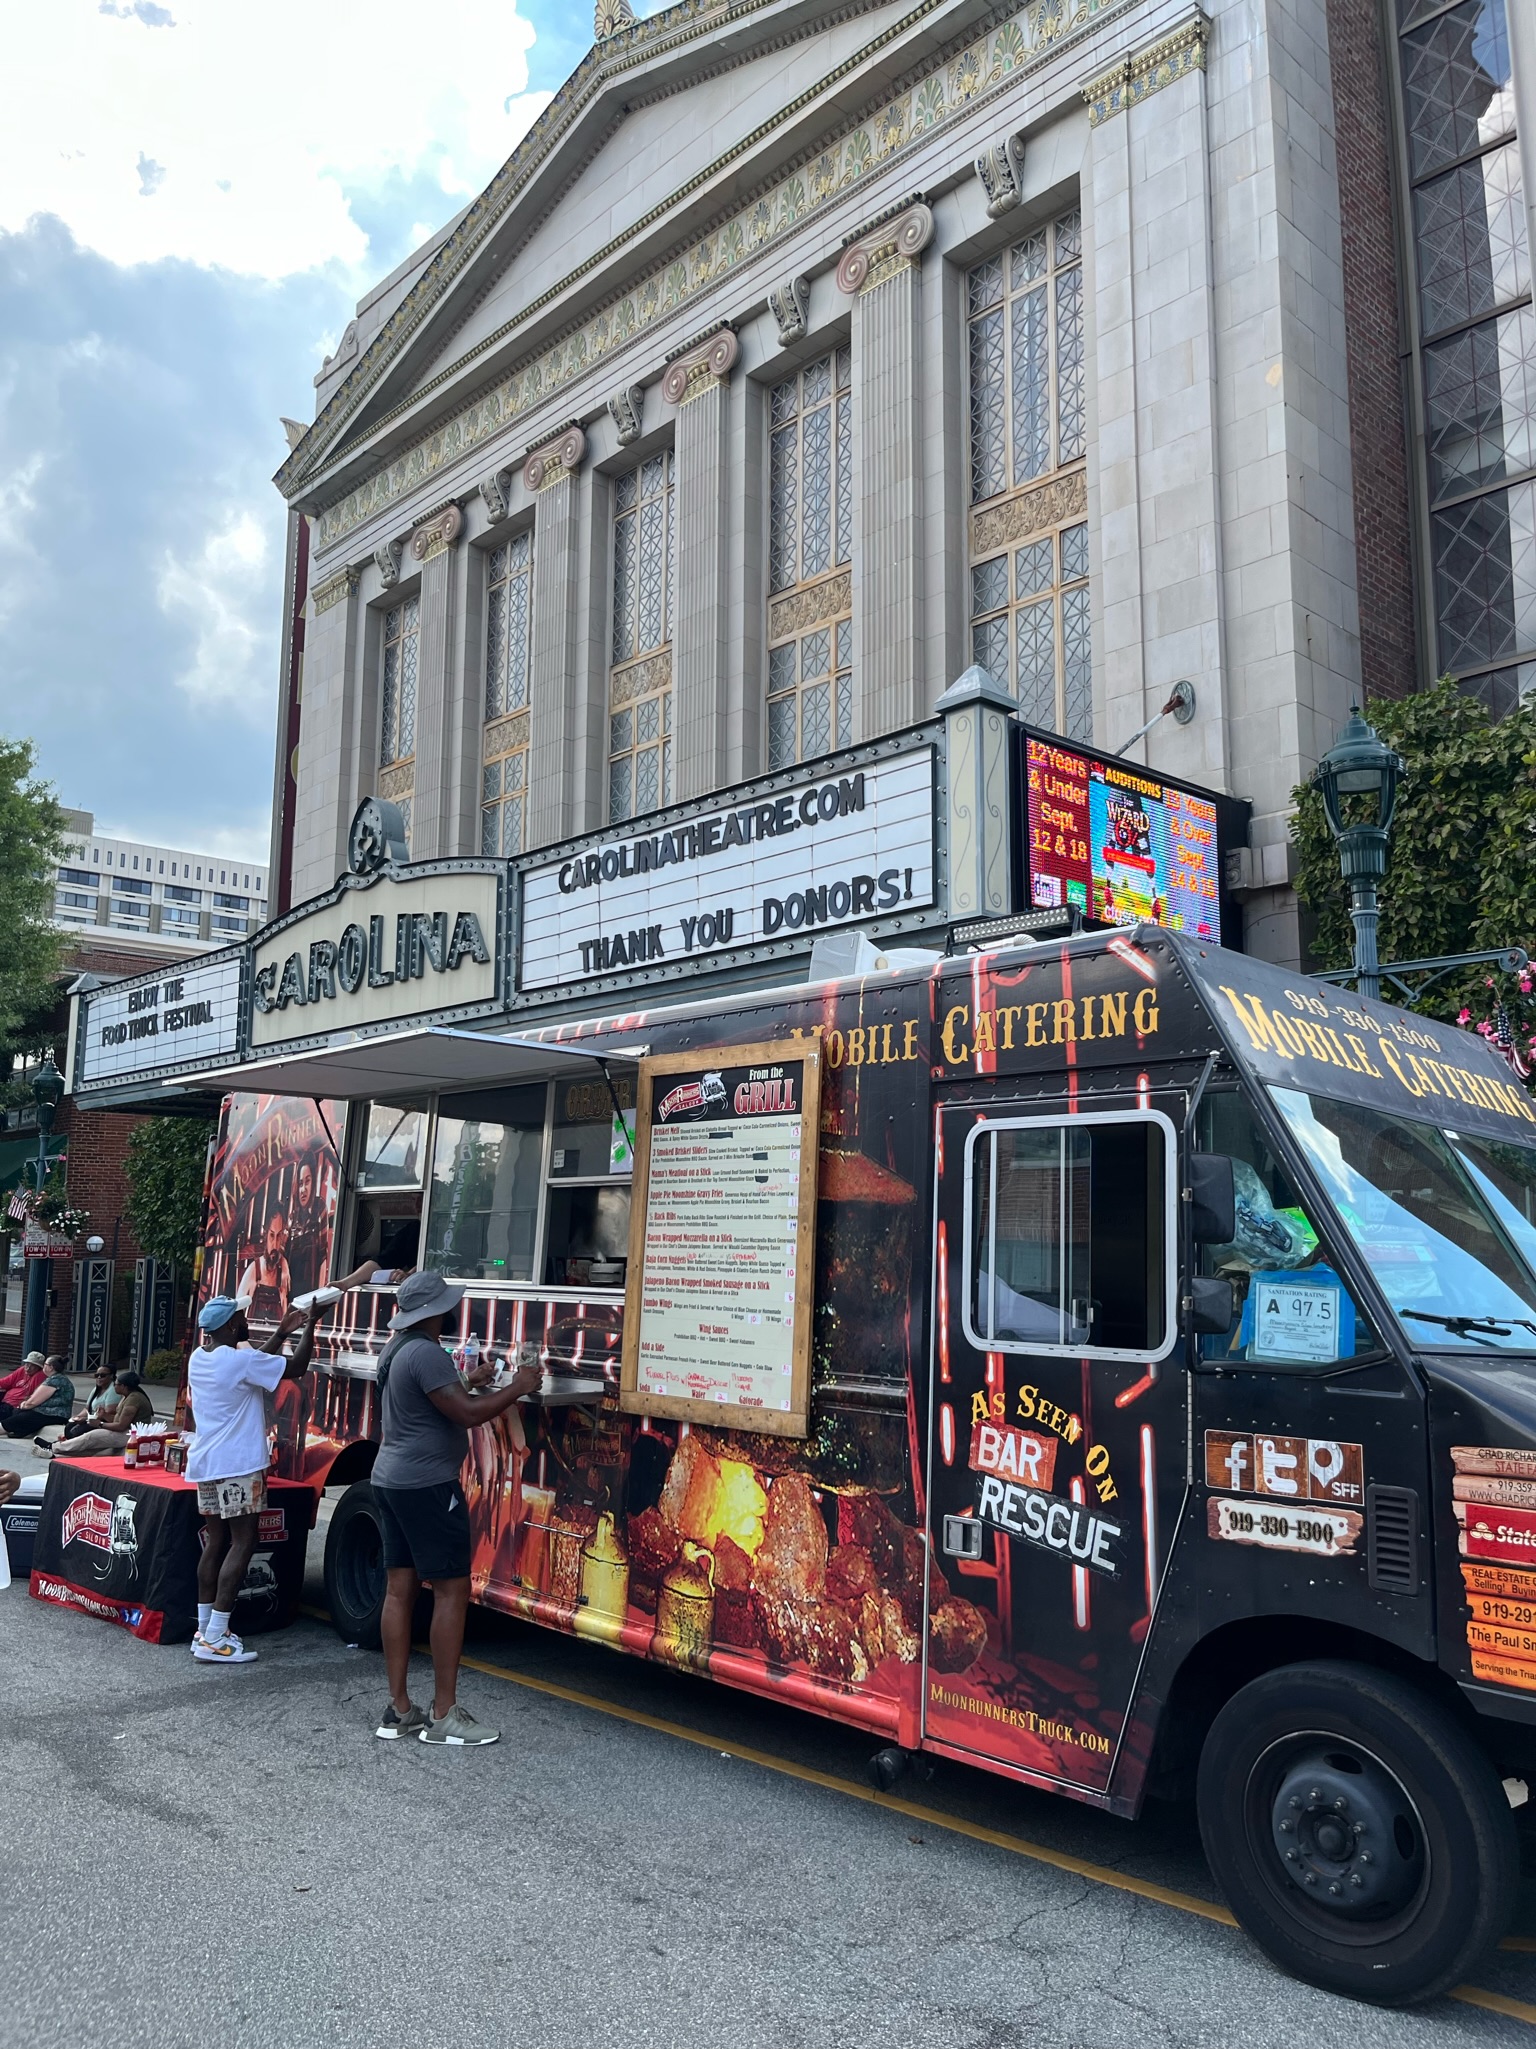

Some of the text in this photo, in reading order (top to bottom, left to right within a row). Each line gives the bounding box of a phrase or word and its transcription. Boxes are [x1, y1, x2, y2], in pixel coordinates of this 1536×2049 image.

[1044, 773, 1088, 806] Under
[1105, 767, 1162, 799] AUDITIONS
[1040, 801, 1079, 833] Sept.
[559, 773, 865, 893] CAROLINATHEATRE.COM
[1183, 821, 1212, 846] Over
[1033, 828, 1088, 861] 12 & 18
[1171, 869, 1186, 889] 14
[579, 868, 913, 972] THANK YOU DONORS!
[254, 911, 490, 1013] CAROLINA
[129, 978, 184, 1013] ENJOY THE
[102, 1000, 213, 1047] FOOD TRUCK FESTIVAL
[941, 988, 1160, 1065] CATERING
[1284, 989, 1441, 1053] 919-330-1300
[1219, 986, 1536, 1123] MOBILE CATERING
[749, 1066, 783, 1080] From the
[734, 1078, 796, 1115] GRILL
[793, 1126, 799, 1136] 13
[657, 1147, 674, 1156] Smoked
[675, 1147, 691, 1156] Brisket
[692, 1146, 707, 1155] Sliders
[652, 1169, 667, 1177] Mama's
[700, 1168, 711, 1176] Stick
[663, 1190, 671, 1199] Pie
[672, 1190, 696, 1199] Moonshine
[697, 1189, 710, 1199] Gravy
[711, 1189, 723, 1198] Fries
[666, 1211, 676, 1220] Ribs
[790, 1222, 797, 1230] 14
[648, 1234, 661, 1242] Bacon
[662, 1234, 682, 1243] Wrapped
[684, 1234, 708, 1242] Mozzarella
[721, 1234, 732, 1242] Stick
[787, 1269, 794, 1277] 10
[644, 1277, 664, 1286] Jalapeno
[666, 1277, 680, 1286] Bacon
[681, 1278, 702, 1287] Wrapped
[703, 1279, 722, 1288] Smoked
[723, 1280, 743, 1290] Sausage
[745, 1281, 751, 1289] on
[757, 1281, 770, 1290] Stick
[1268, 1289, 1327, 1299] SANITATION RATING
[644, 1298, 658, 1307] Jumbo
[659, 1299, 672, 1309] Wings
[1266, 1298, 1331, 1320] A 97.5
[92, 1299, 102, 1340] CROWN
[157, 1301, 167, 1344] CROWN
[699, 1324, 729, 1335] Wing Sauces
[640, 1382, 650, 1392] Soda
[658, 1385, 664, 1393] 2
[692, 1389, 706, 1399] Water
[718, 1393, 725, 1401] 2
[739, 1395, 763, 1406] Gatorade
[784, 1401, 789, 1409] 3
[1017, 1384, 1083, 1446] SEEN
[1086, 1444, 1118, 1503] ON
[977, 1425, 1043, 1482] BAR
[1478, 1449, 1504, 1460] CHAD
[1495, 1461, 1524, 1475] STATE
[1331, 1482, 1360, 1498] SFF
[10, 1517, 38, 1527] Coleman
[979, 1477, 1121, 1571] RESCUE
[1229, 1511, 1334, 1544] 919-330-1300
[1496, 1525, 1536, 1547] State
[1472, 1568, 1530, 1586] REAL ESTATE
[1474, 1578, 1505, 1594] Selling!
[1470, 1627, 1491, 1642] The
[1494, 1632, 1519, 1648] Paul
[1475, 1661, 1504, 1676] Serving
[1505, 1667, 1518, 1676] the
